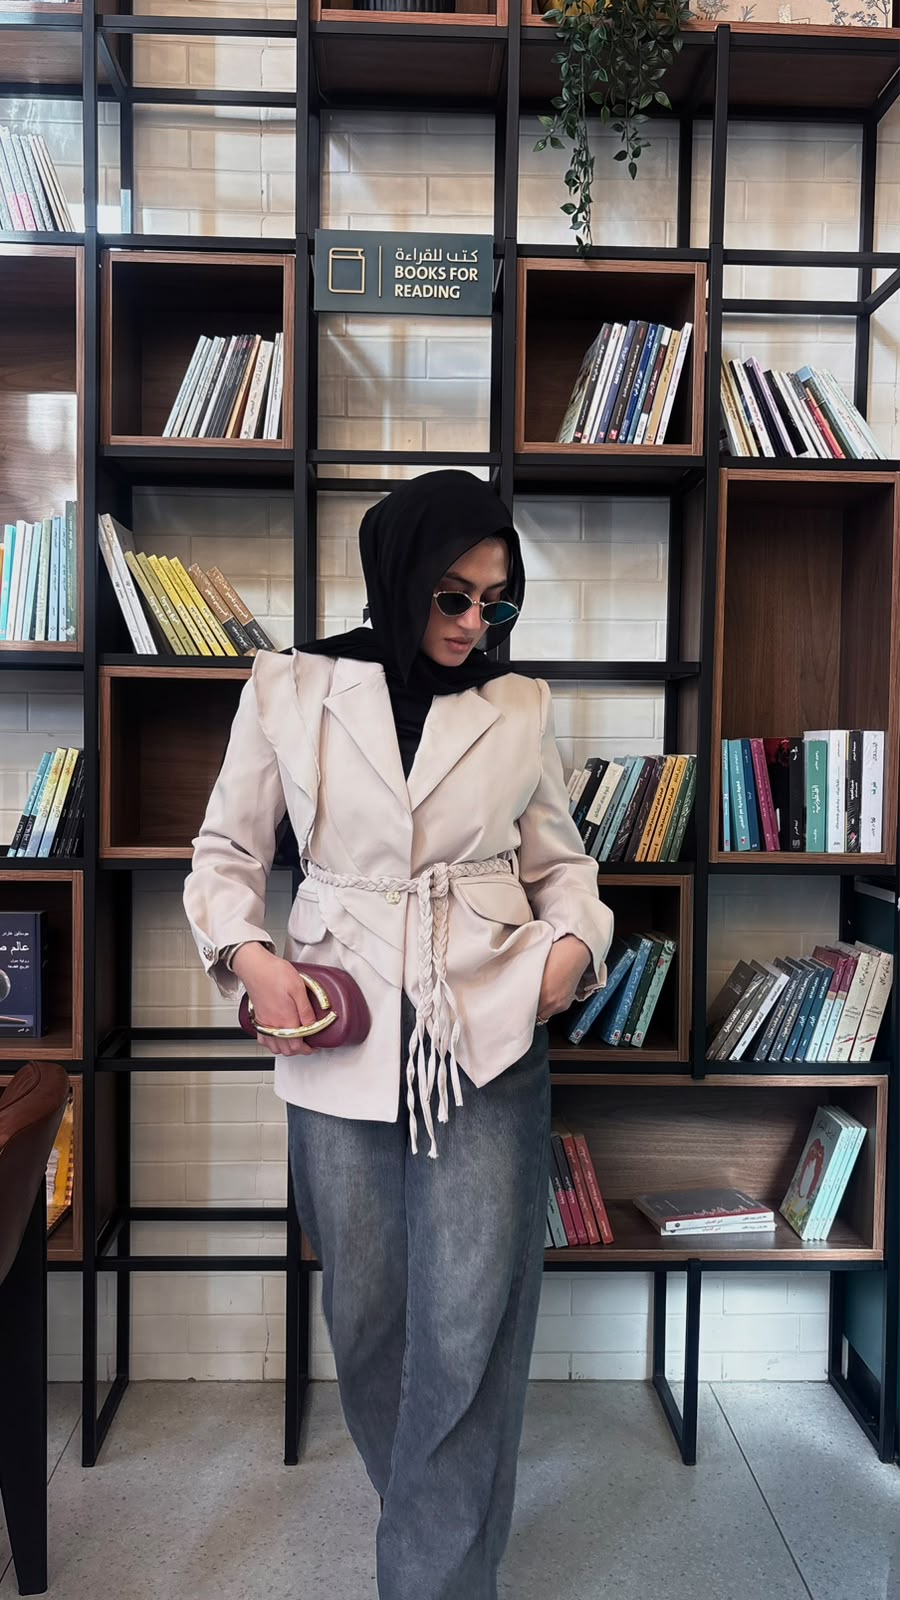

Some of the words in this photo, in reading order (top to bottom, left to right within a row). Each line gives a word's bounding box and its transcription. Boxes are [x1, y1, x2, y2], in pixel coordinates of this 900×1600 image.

[395, 247, 443, 265] للقراءة
[446, 249, 479, 264] كتب
[394, 265, 447, 281] BOOKS
[449, 267, 479, 282] FOR
[394, 284, 461, 300] READING
